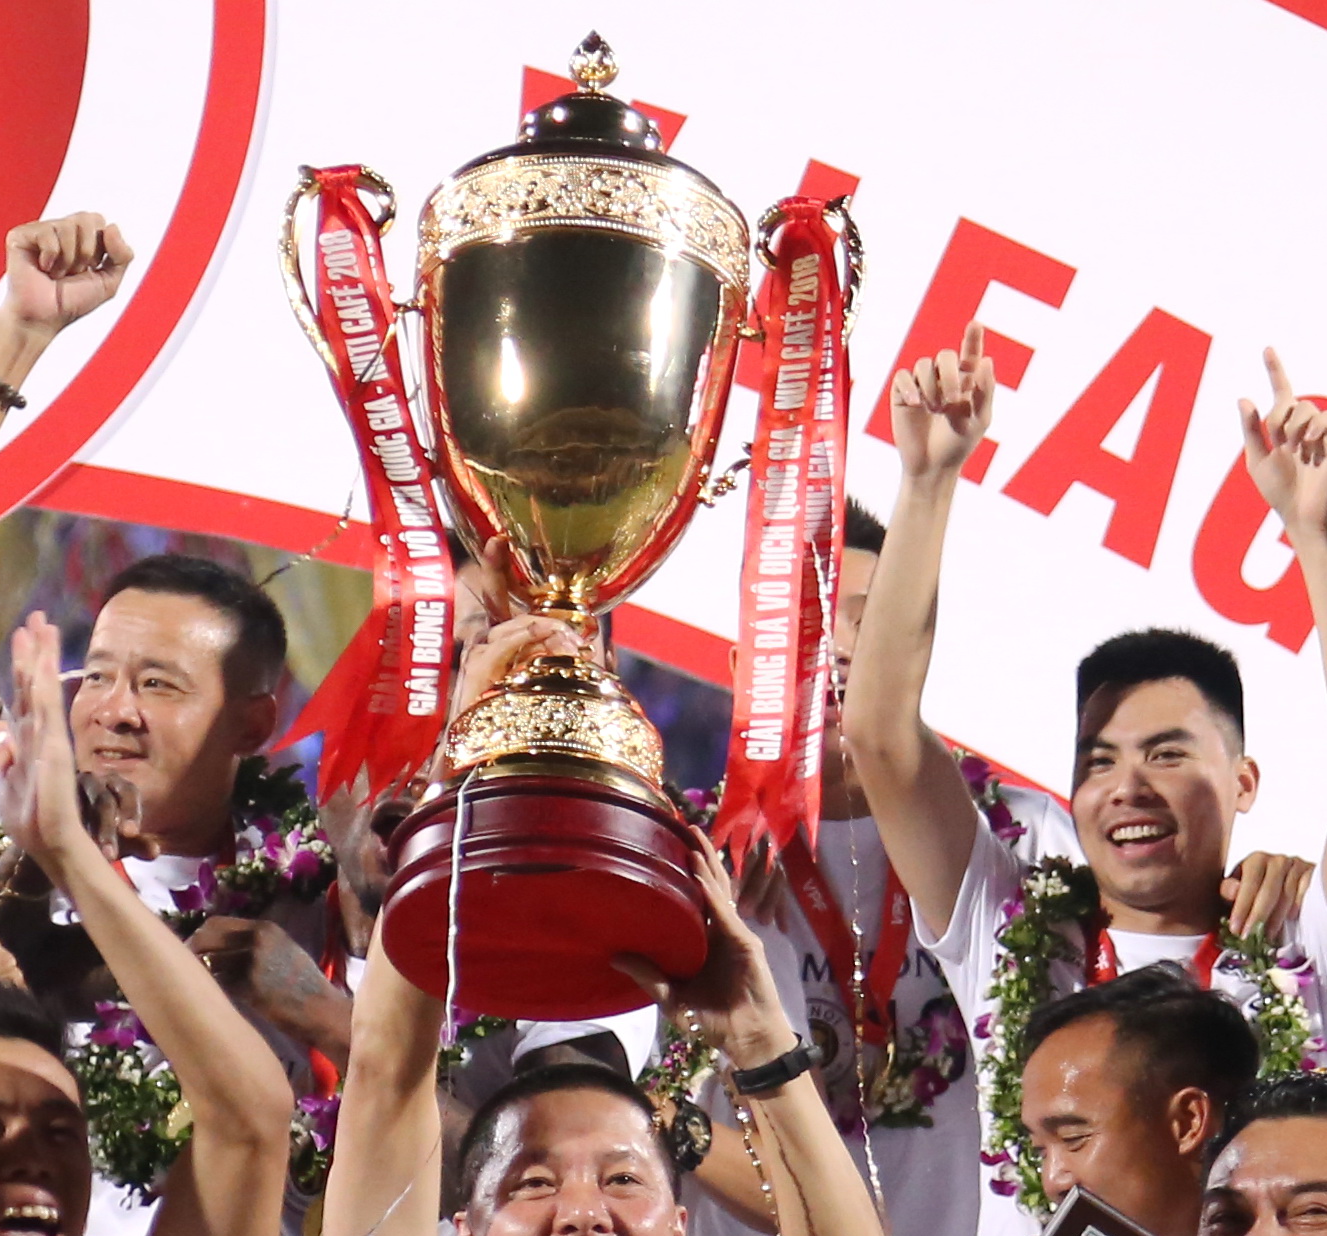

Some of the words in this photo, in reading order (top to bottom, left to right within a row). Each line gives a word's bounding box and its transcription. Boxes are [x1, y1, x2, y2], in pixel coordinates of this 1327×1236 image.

[319, 229, 363, 280] 2018
[787, 252, 821, 307] 2018
[326, 282, 375, 334] CAFÉ
[779, 307, 817, 360] CAFÉ
[773, 362, 812, 410] NUTI
[364, 393, 403, 431] GIA
[767, 424, 804, 461] GIA
[398, 530, 441, 559] VÔ
[758, 525, 798, 576] ĐỊCH
[406, 563, 445, 595] ĐÁ
[753, 579, 791, 613] VÔ
[409, 600, 446, 663] BÓNG
[753, 616, 790, 650] ĐÁ
[404, 667, 440, 716] GIẢI
[746, 655, 787, 717] BÓNG
[740, 717, 783, 762] GIẢI
